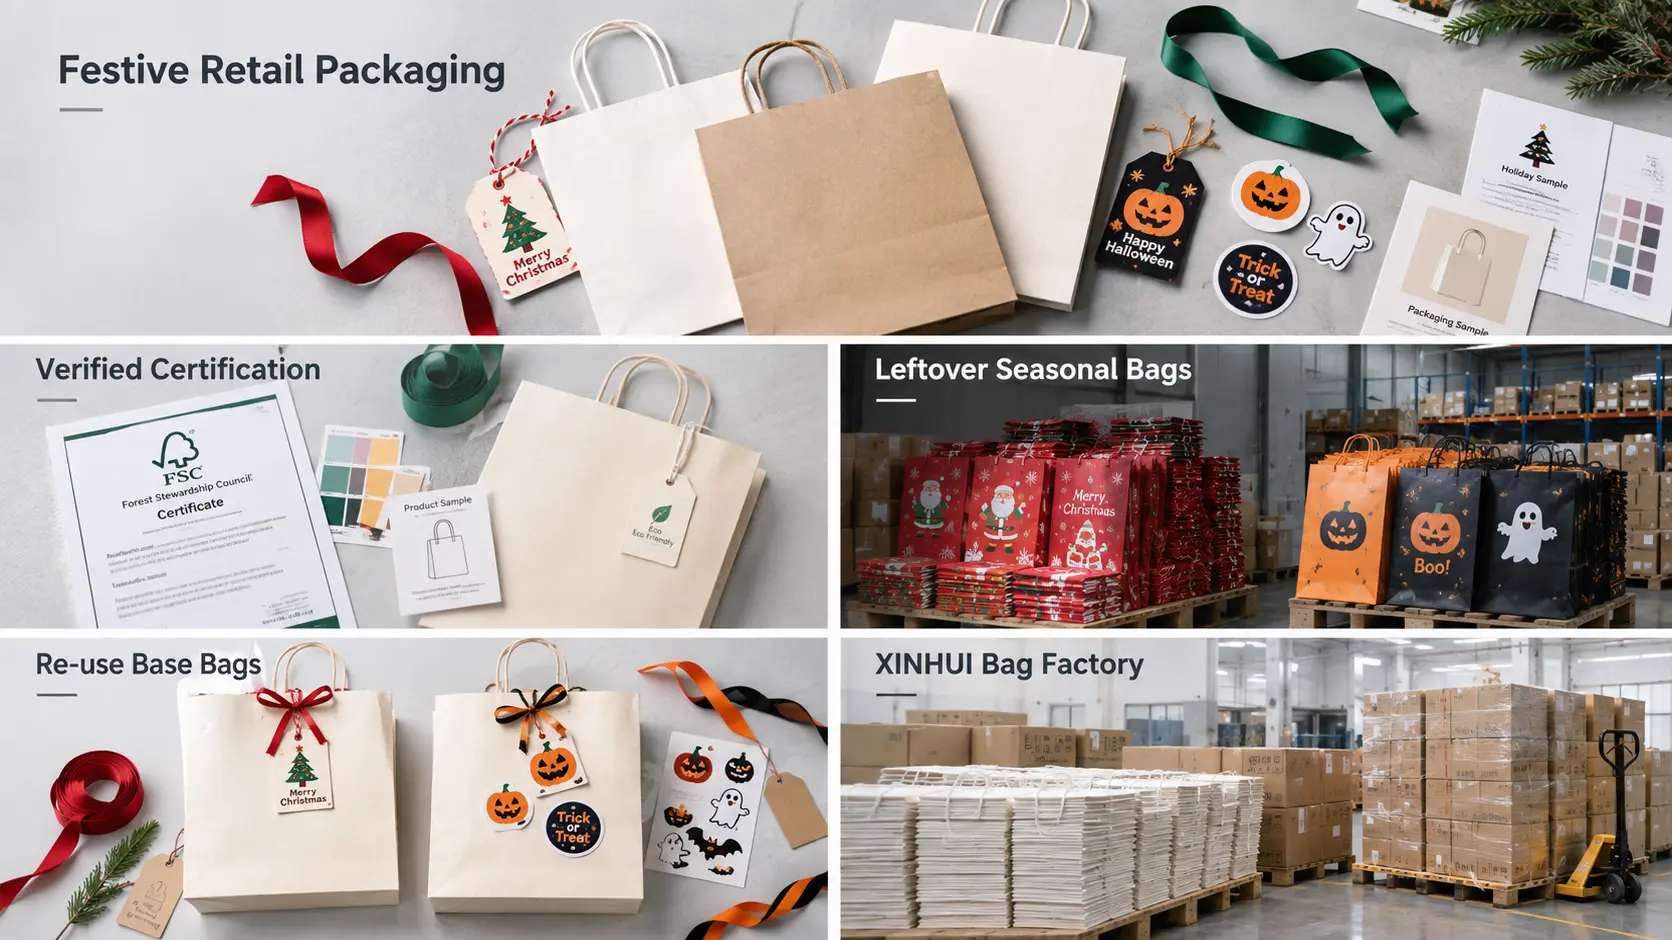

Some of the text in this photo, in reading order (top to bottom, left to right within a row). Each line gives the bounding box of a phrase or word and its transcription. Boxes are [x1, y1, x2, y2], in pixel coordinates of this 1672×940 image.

[1501, 164, 1569, 190] Holiday Sample
[1104, 240, 1174, 270] Halloween
[1122, 231, 1166, 256] Happy
[506, 253, 570, 287] Christmas
[513, 248, 551, 270] Merry
[1238, 253, 1281, 280] Trick
[1230, 277, 1275, 305] Treat
[1247, 273, 1266, 287] or
[1407, 304, 1454, 328] Packaging
[1455, 320, 1489, 336] Sample
[163, 465, 204, 487] FSC
[122, 495, 154, 510] Forest
[155, 483, 214, 503] Stewardship
[404, 496, 472, 512] Product Sample
[1072, 488, 1106, 506] Merry
[157, 498, 224, 521] Certificate
[1414, 557, 1451, 575] Boo!
[556, 811, 591, 824] Trick
[566, 824, 580, 833] or
